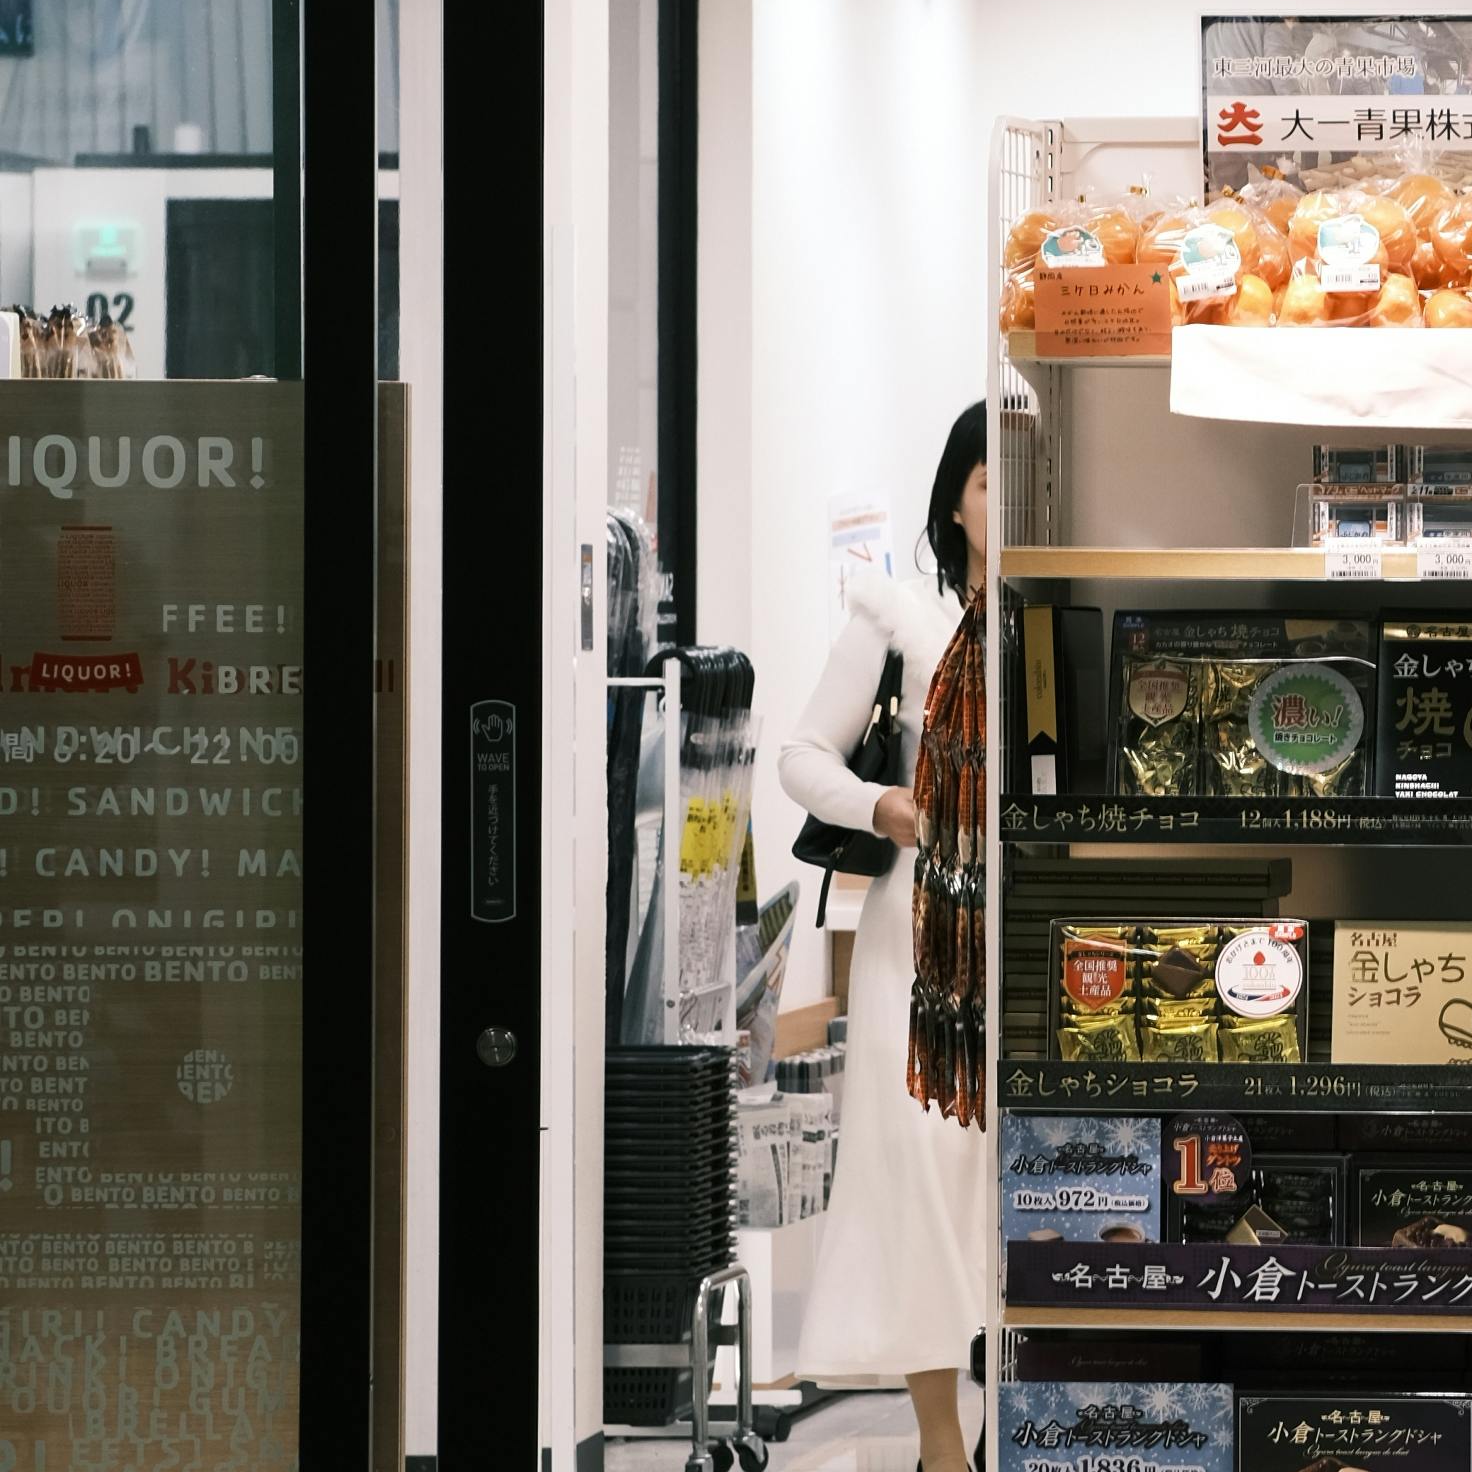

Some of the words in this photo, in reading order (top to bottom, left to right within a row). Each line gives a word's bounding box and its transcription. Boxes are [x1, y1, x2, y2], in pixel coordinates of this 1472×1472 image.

[1213, 55, 1417, 78] 東三河最大の青果市場
[163, 604, 285, 634] FFEE!
[1424, 625, 1471, 638] 名古屋
[41, 662, 132, 683] LIQUOR!
[1395, 686, 1456, 735] 焼
[1273, 732, 1337, 745] 焼きチョコレート
[477, 753, 510, 763] WAVE
[1397, 740, 1453, 760] チョコ
[1001, 802, 1199, 832] 金しゃち焼チョコ
[35, 847, 211, 877] CANDY!
[238, 847, 301, 877] MA
[1350, 932, 1397, 947] 名古屋
[63, 964, 136, 981] BENTO
[145, 960, 249, 982] BENTO
[1073, 959, 1118, 972] 全国推奨
[1350, 950, 1466, 983] 金しゃち
[1079, 984, 1112, 997] 土産品
[1348, 985, 1421, 1008] ショコラ
[10, 1031, 83, 1048] BENTO
[1005, 1071, 1199, 1097] 金しゃちショコラ
[1011, 1155, 1153, 1175] 小倉トーストラングドシャ
[71, 1187, 135, 1202] BENTO
[143, 1186, 215, 1202] BENTO
[223, 1188, 280, 1201] BENTO
[180, 1258, 240, 1272] BENTO
[1069, 1263, 1168, 1290] 名古屋
[1083, 1405, 1135, 1419] 名古屋
[1328, 1409, 1382, 1424] 名古屋
[1014, 1420, 1207, 1448] 小倉トーストラングドシャ
[1267, 1420, 1443, 1446] 小倉トーストラングドシャ
